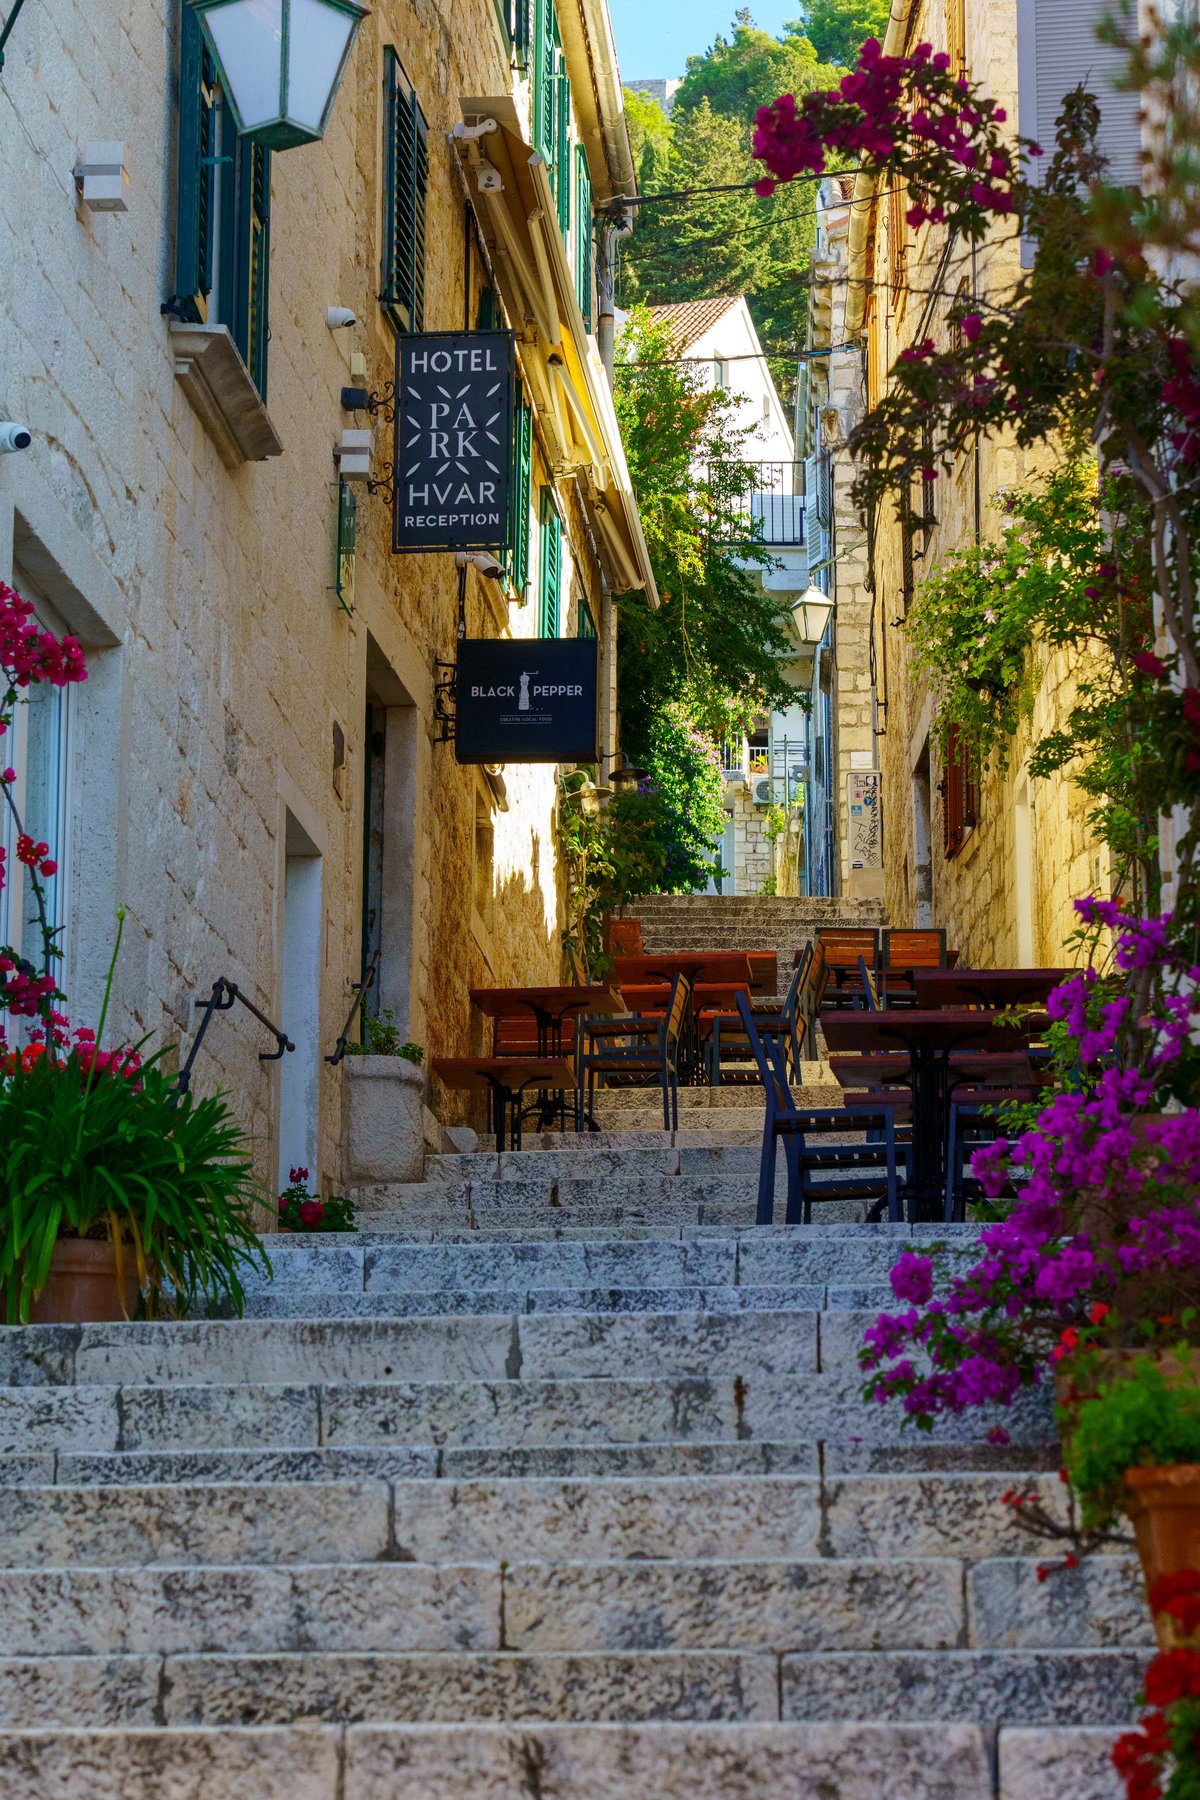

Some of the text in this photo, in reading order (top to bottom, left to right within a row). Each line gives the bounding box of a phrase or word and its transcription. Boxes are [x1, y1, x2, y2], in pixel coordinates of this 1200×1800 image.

[411, 349, 497, 374] HOTEL
[408, 481, 496, 506] HVAR
[404, 512, 500, 528] RECEPTION
[471, 684, 583, 697] BLACK PEPPER
